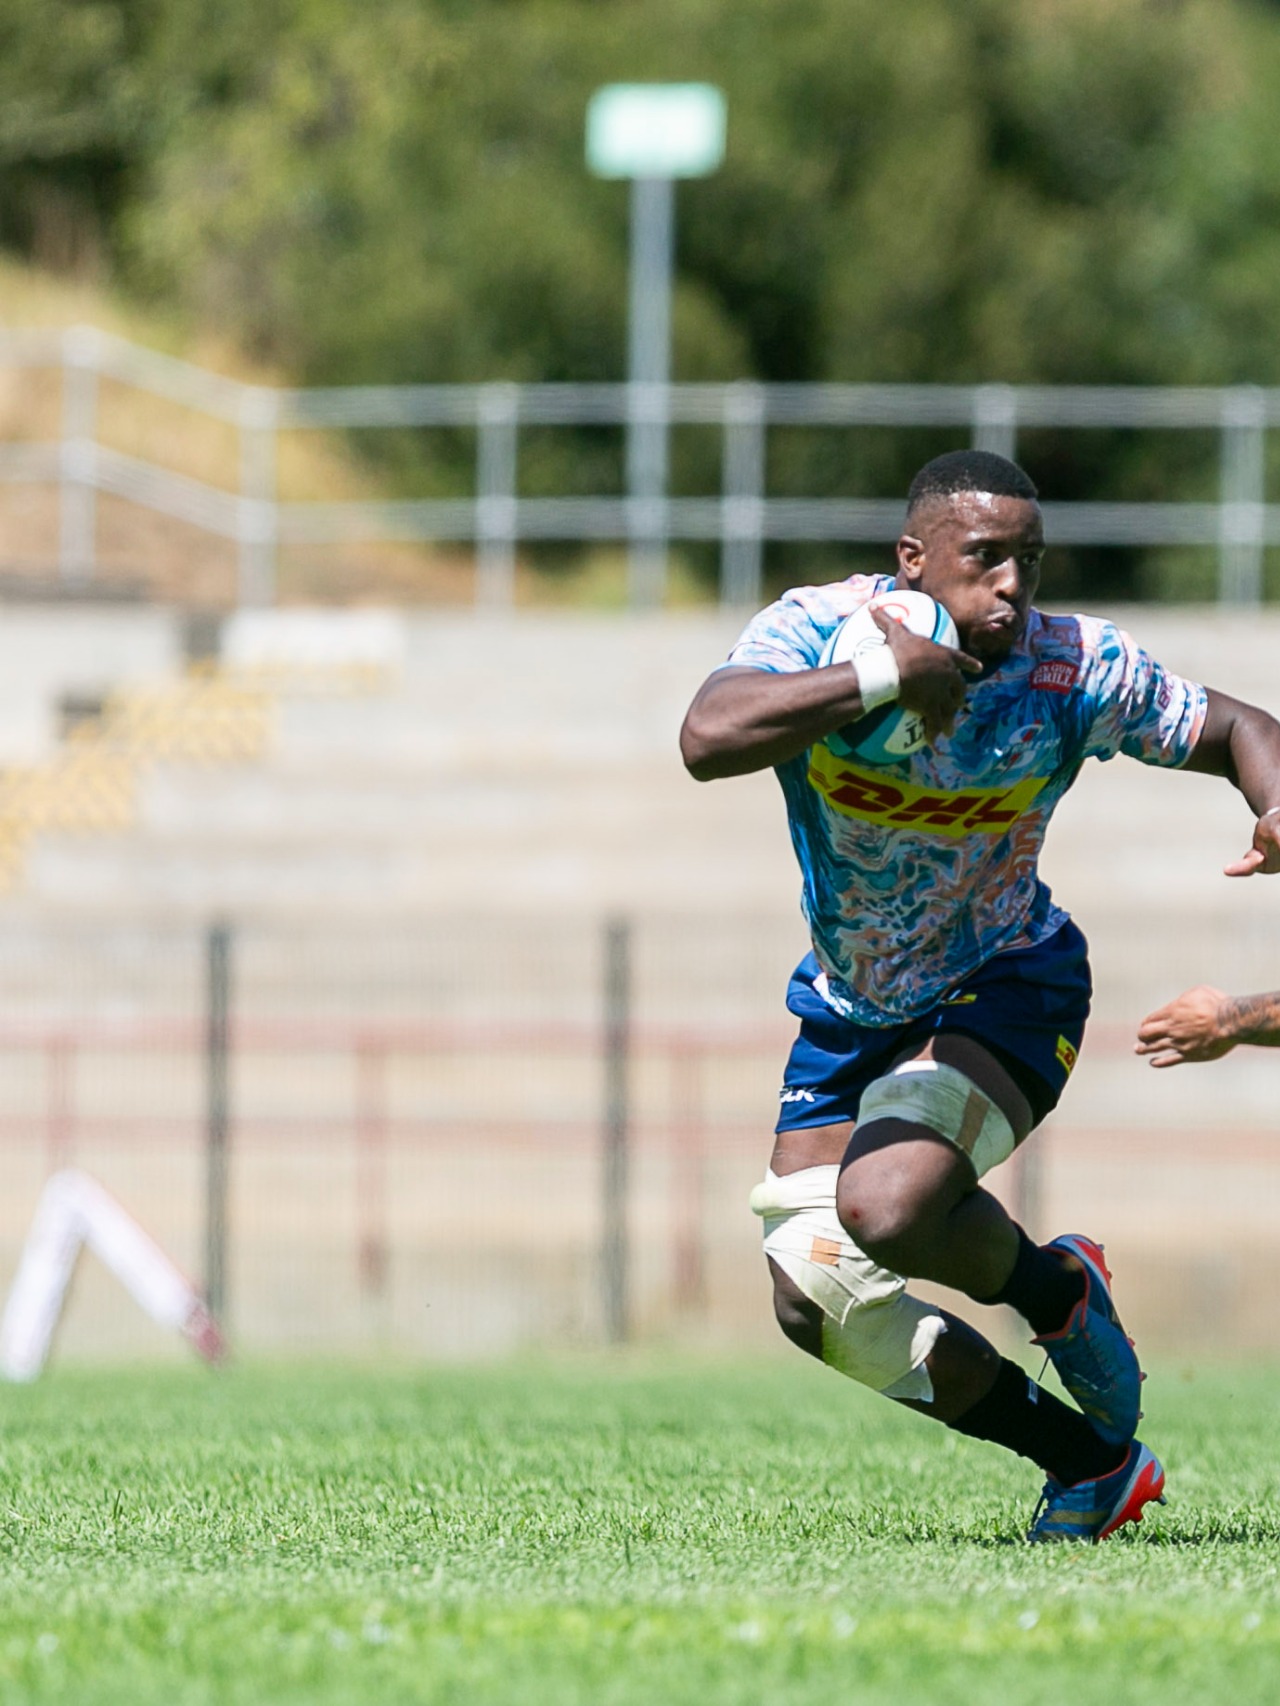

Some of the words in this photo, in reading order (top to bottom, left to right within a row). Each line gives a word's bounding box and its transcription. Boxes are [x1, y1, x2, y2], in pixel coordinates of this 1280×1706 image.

[1050, 662, 1075, 676] GUN
[1033, 671, 1072, 688] GRILL
[826, 769, 1022, 830] DHL
